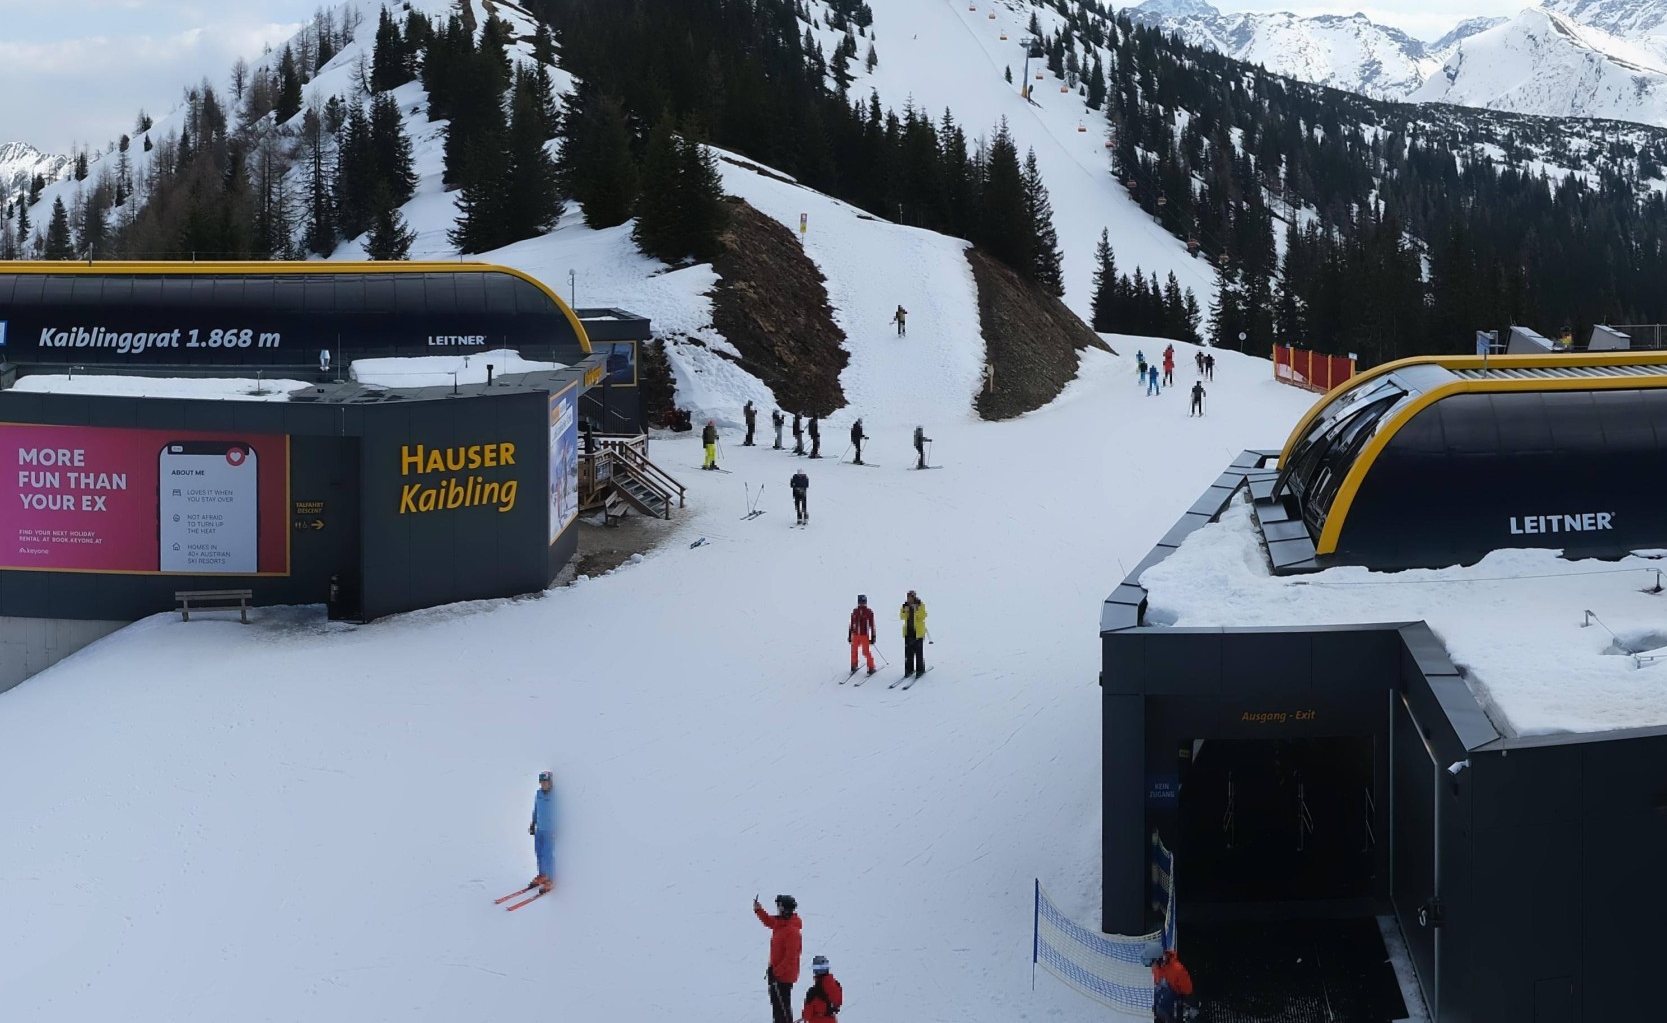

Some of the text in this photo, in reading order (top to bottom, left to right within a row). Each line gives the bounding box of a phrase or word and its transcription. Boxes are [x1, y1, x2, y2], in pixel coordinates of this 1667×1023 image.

[39, 327, 281, 354] Kaiblinggrat 1.868 m
[428, 335, 486, 346] LEITNER
[18, 448, 85, 467] MORE
[401, 442, 516, 475] HAUSER
[18, 471, 127, 490] FUN THAN
[19, 493, 107, 512] YOUR EX
[399, 476, 518, 514] Kaibling
[1510, 512, 1613, 534] LEITNER
[26, 547, 49, 555] keyone
[1241, 711, 1287, 723] Ausgang
[1295, 709, 1316, 720] Exit
